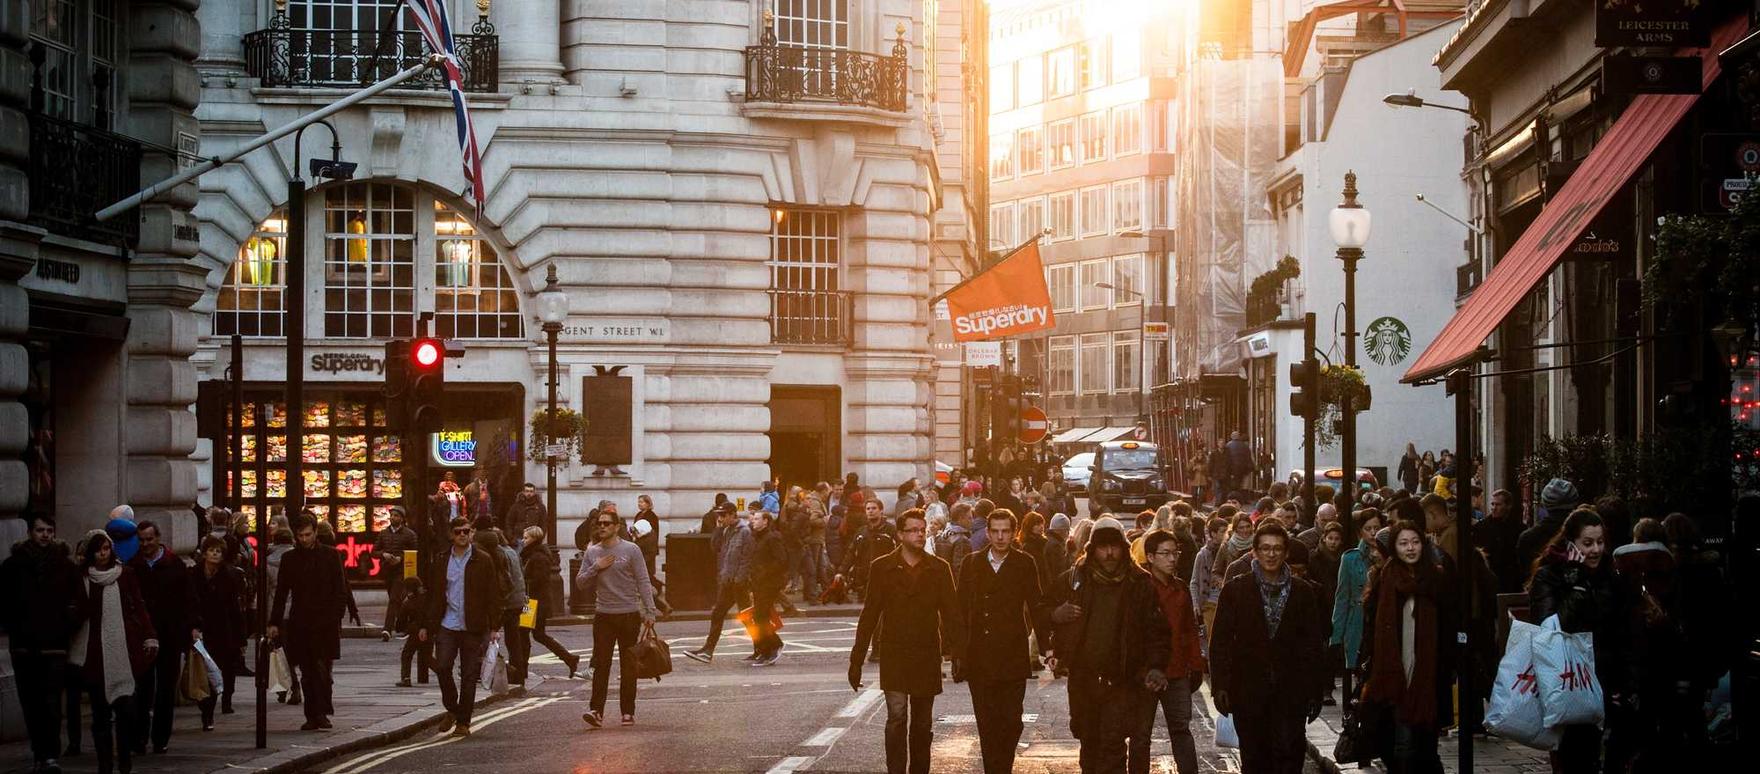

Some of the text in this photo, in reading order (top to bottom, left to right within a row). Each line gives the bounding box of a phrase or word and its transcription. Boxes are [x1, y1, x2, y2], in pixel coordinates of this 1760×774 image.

[1618, 20, 1690, 31] LEICESTER
[1635, 32, 1674, 42] ARMS
[955, 304, 1048, 335] Superdry
[558, 326, 594, 336] GENT
[602, 326, 643, 336] STREET
[311, 354, 386, 375] Superdry
[439, 431, 473, 442] T-SHIRT
